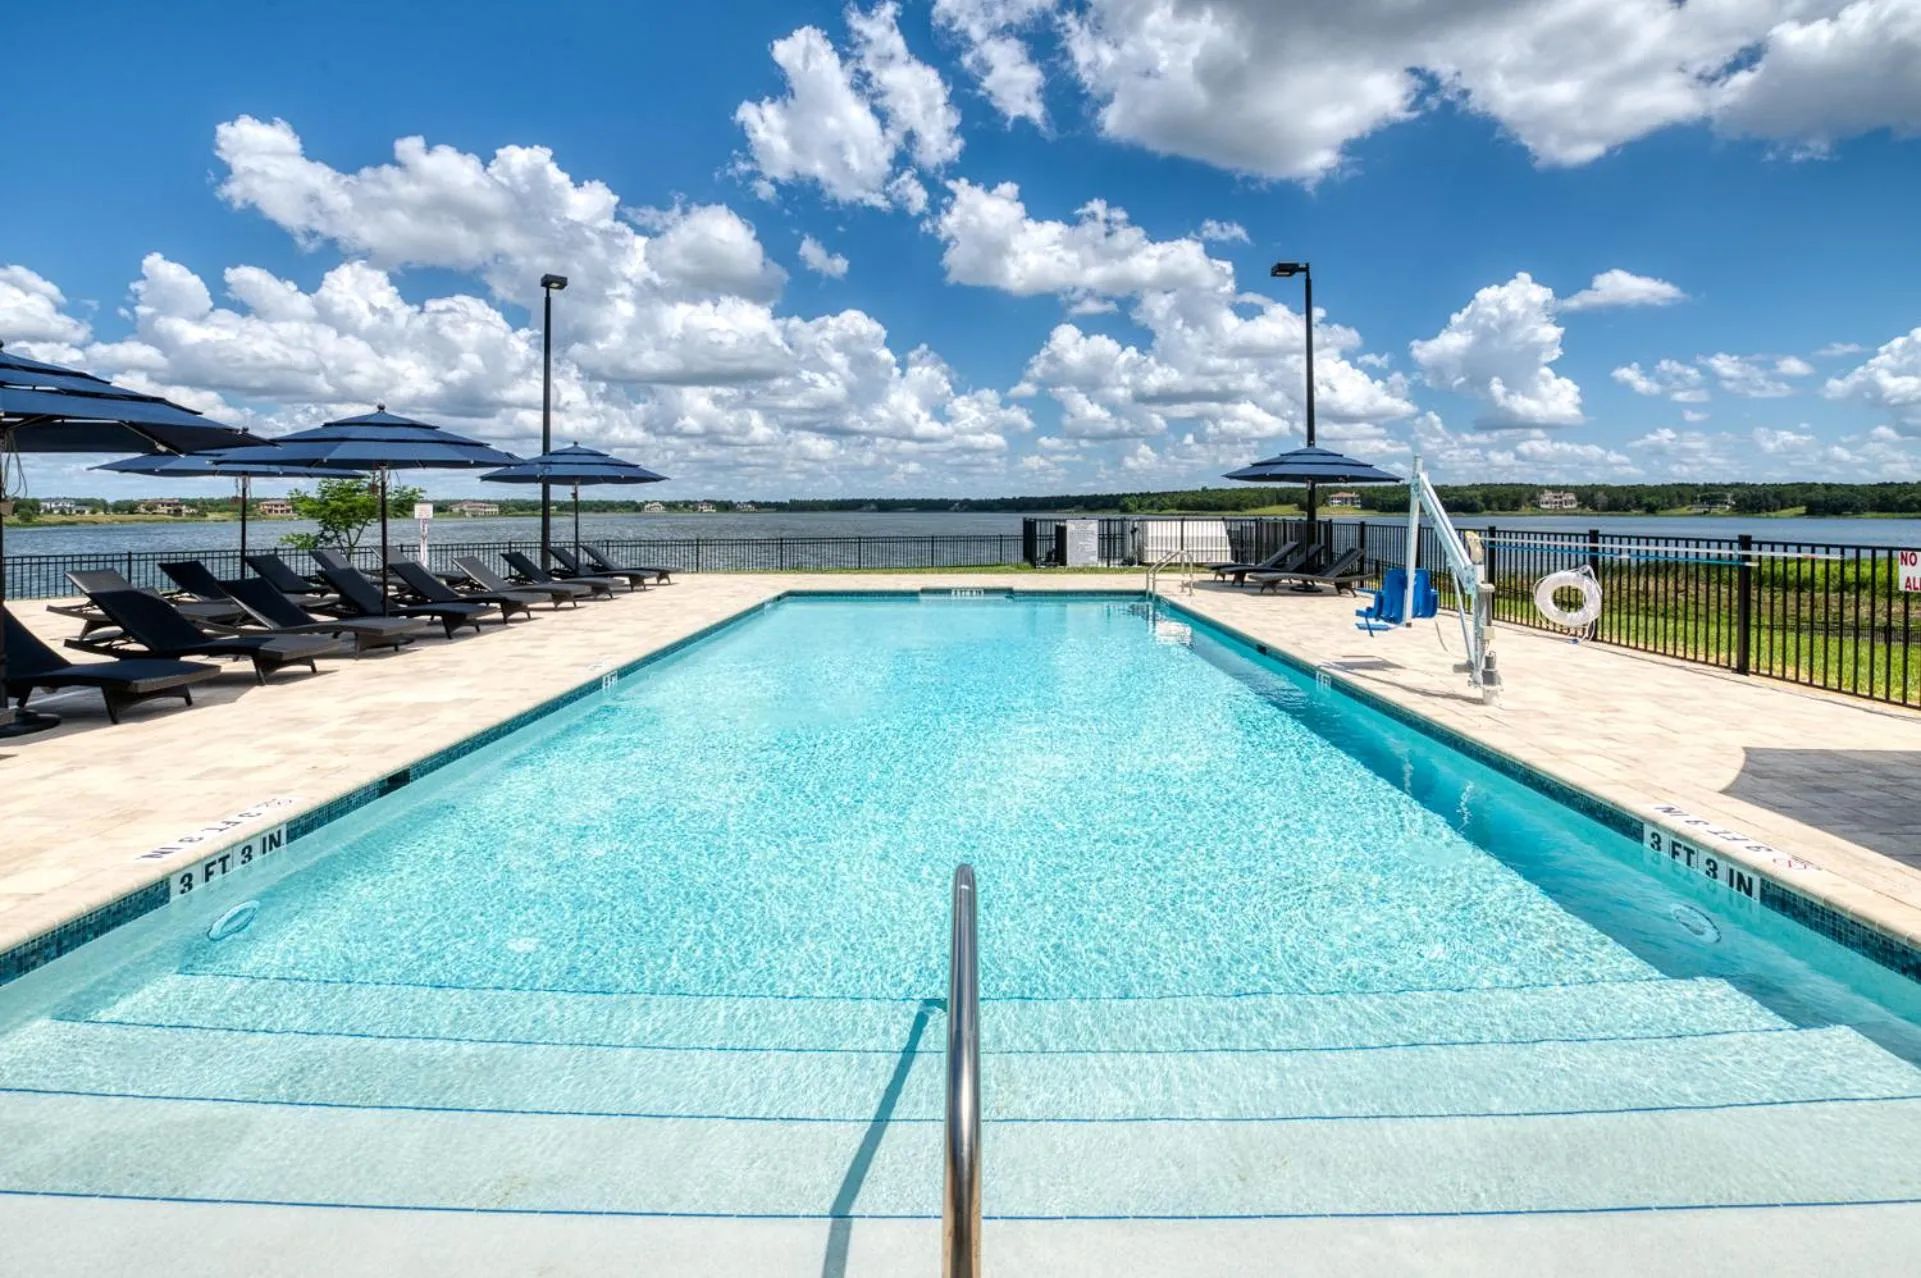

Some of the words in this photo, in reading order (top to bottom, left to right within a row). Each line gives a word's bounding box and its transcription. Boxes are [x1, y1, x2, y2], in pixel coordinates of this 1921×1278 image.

[1900, 551, 1918, 567] NO
[1905, 576, 1921, 591] AL
[179, 872, 194, 895] 3
[204, 854, 231, 884] FT
[240, 844, 254, 865] 3
[262, 829, 283, 856] IN
[1650, 832, 1662, 852] 3
[1671, 841, 1696, 867] FT
[1705, 858, 1719, 880] 3
[1728, 868, 1754, 898] IN
